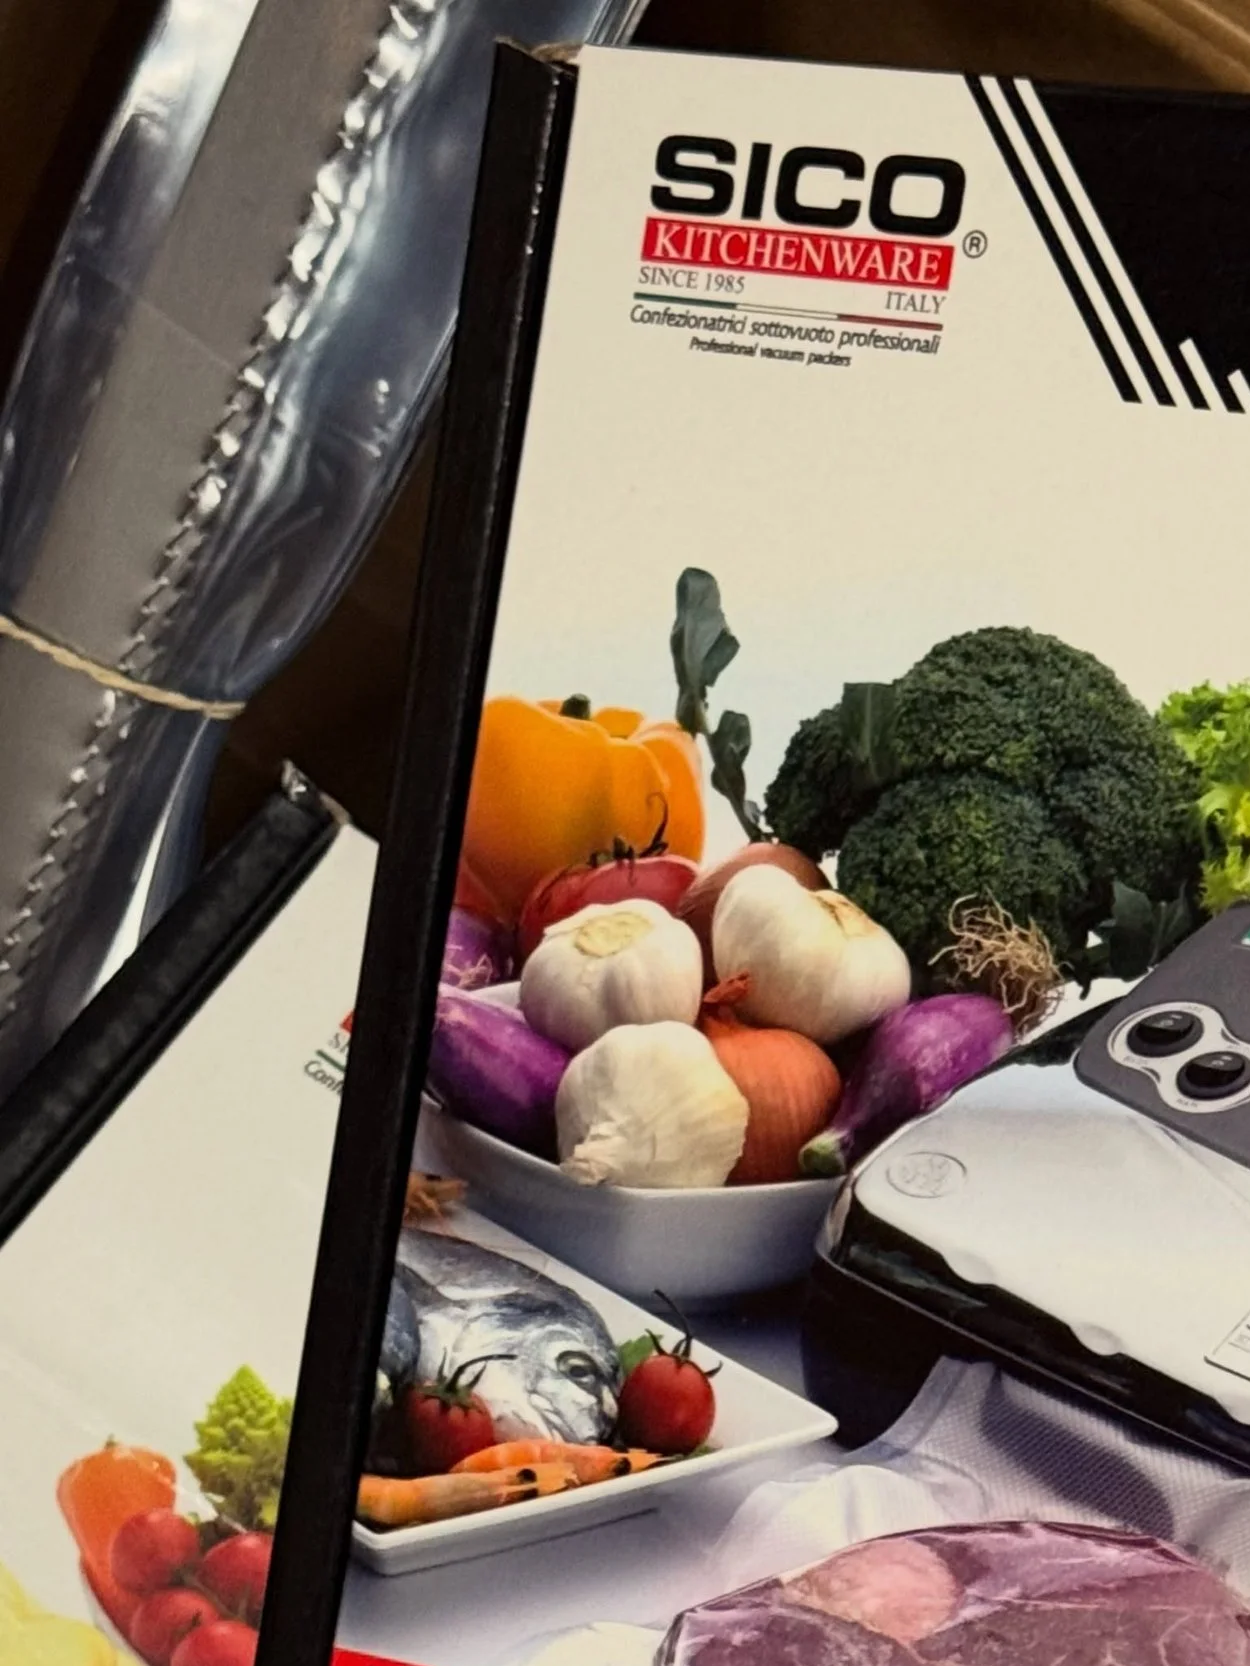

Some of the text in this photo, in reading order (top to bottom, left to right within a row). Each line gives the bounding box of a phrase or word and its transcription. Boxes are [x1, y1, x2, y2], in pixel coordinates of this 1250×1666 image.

[650, 134, 966, 238] SICO
[653, 222, 943, 286] KITCHENWARE
[639, 266, 745, 294] SINCE 1985
[884, 290, 946, 315] ITALY
[630, 304, 942, 355] Confezionatrici sottovuoto professionali
[689, 336, 853, 366] Professional vacuum packers
